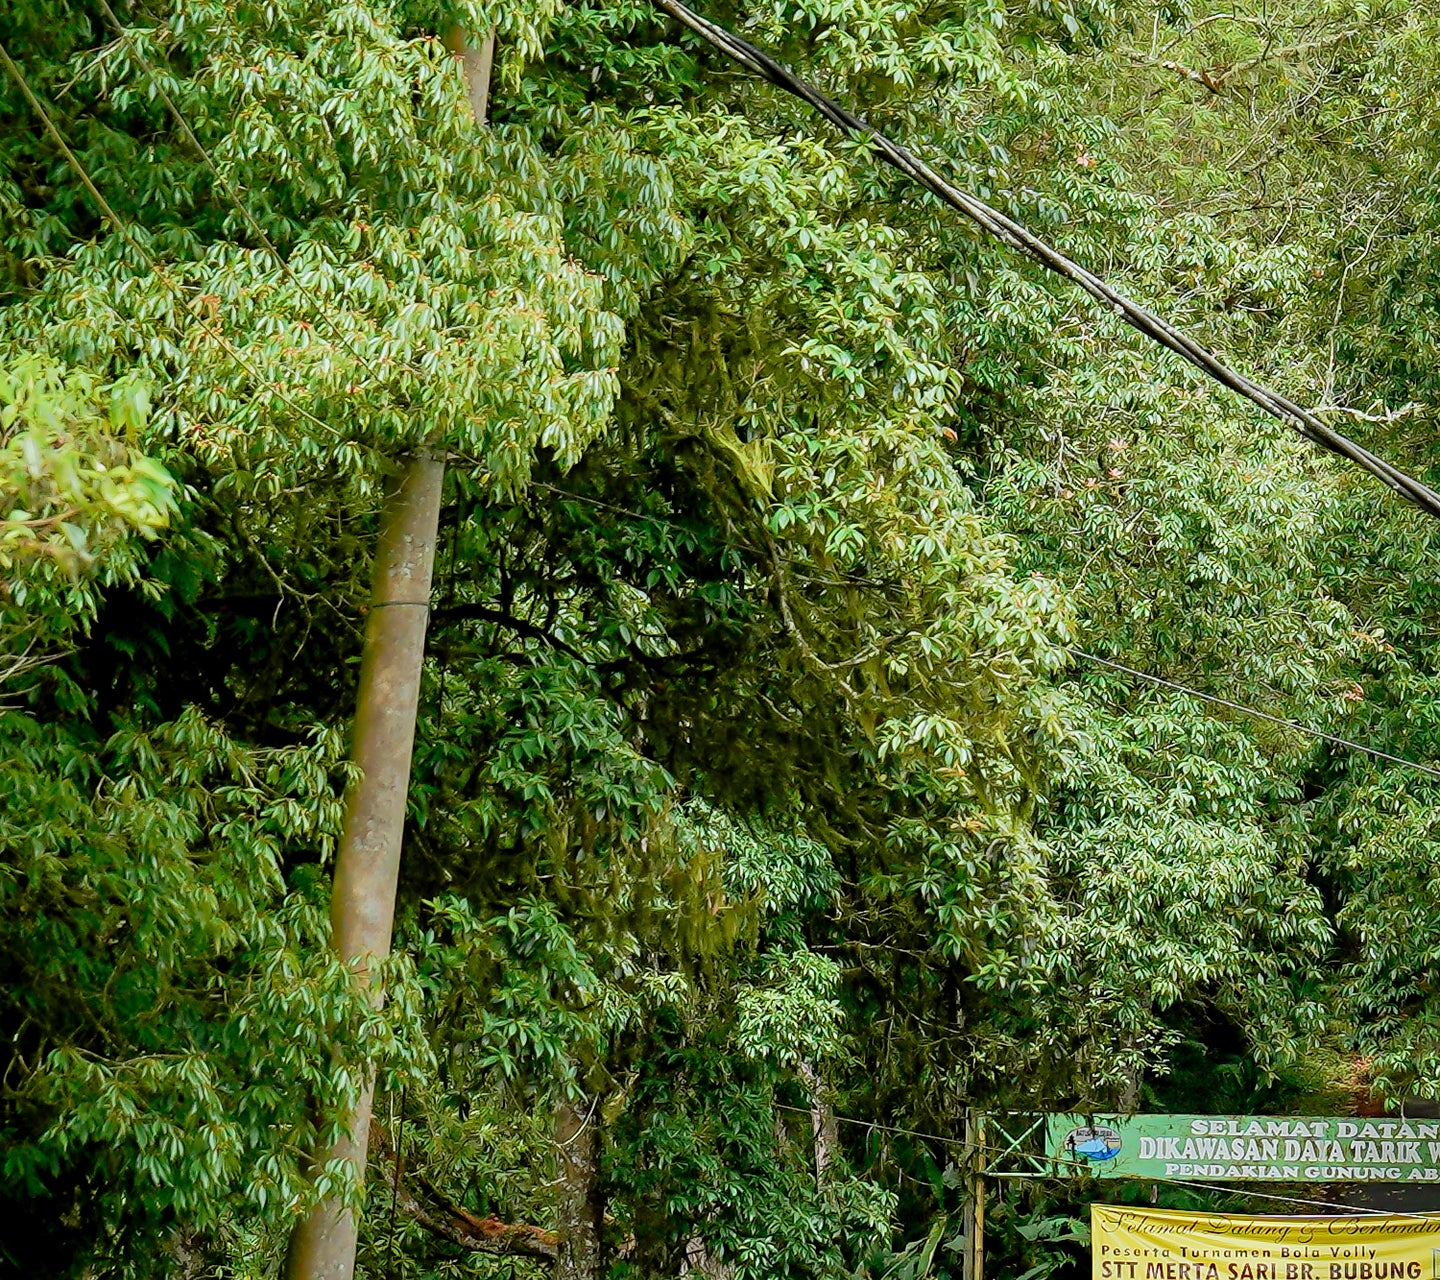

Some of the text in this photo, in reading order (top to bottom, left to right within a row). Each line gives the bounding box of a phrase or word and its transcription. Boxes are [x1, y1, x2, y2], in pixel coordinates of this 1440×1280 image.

[1189, 1119, 1329, 1138] SELAMAT
[1138, 1136, 1279, 1161] DIKAWASAN
[1284, 1138, 1345, 1163] DAYA
[1351, 1140, 1423, 1164] TARIK
[1164, 1163, 1299, 1178] PENDAKIAN
[1304, 1165, 1401, 1180] GUNUNG
[1101, 1211, 1199, 1234] Selamat
[1203, 1215, 1292, 1243] Datang
[1101, 1245, 1377, 1260] Peserta Turnamen Bola Volly
[1101, 1261, 1422, 1280] STT MERTA SARI BR. BUBUNG
